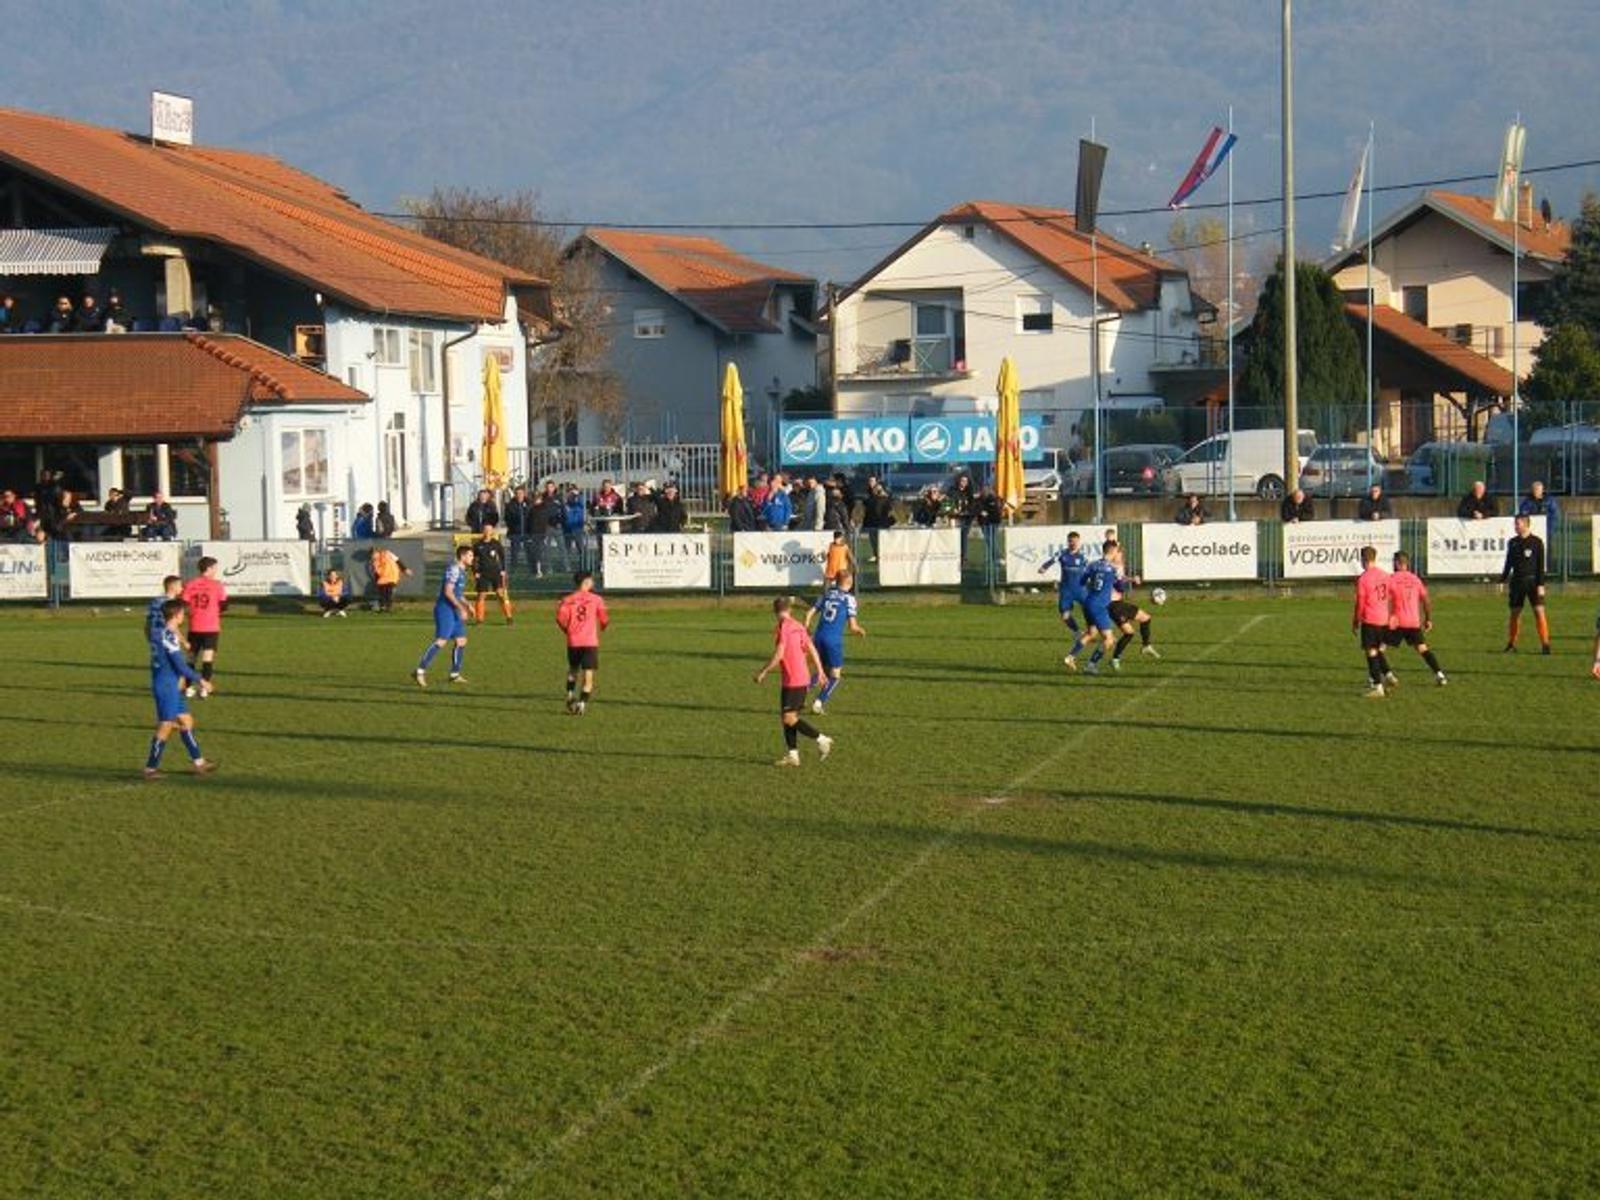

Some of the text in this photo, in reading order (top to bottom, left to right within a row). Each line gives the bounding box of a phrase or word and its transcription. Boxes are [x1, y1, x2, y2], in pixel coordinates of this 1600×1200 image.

[827, 426, 906, 454] JAKO
[957, 425, 1039, 452] JAO
[1168, 541, 1251, 557] Accolade
[1375, 583, 1387, 601] 13
[192, 593, 210, 610] 19
[576, 605, 587, 622] 8
